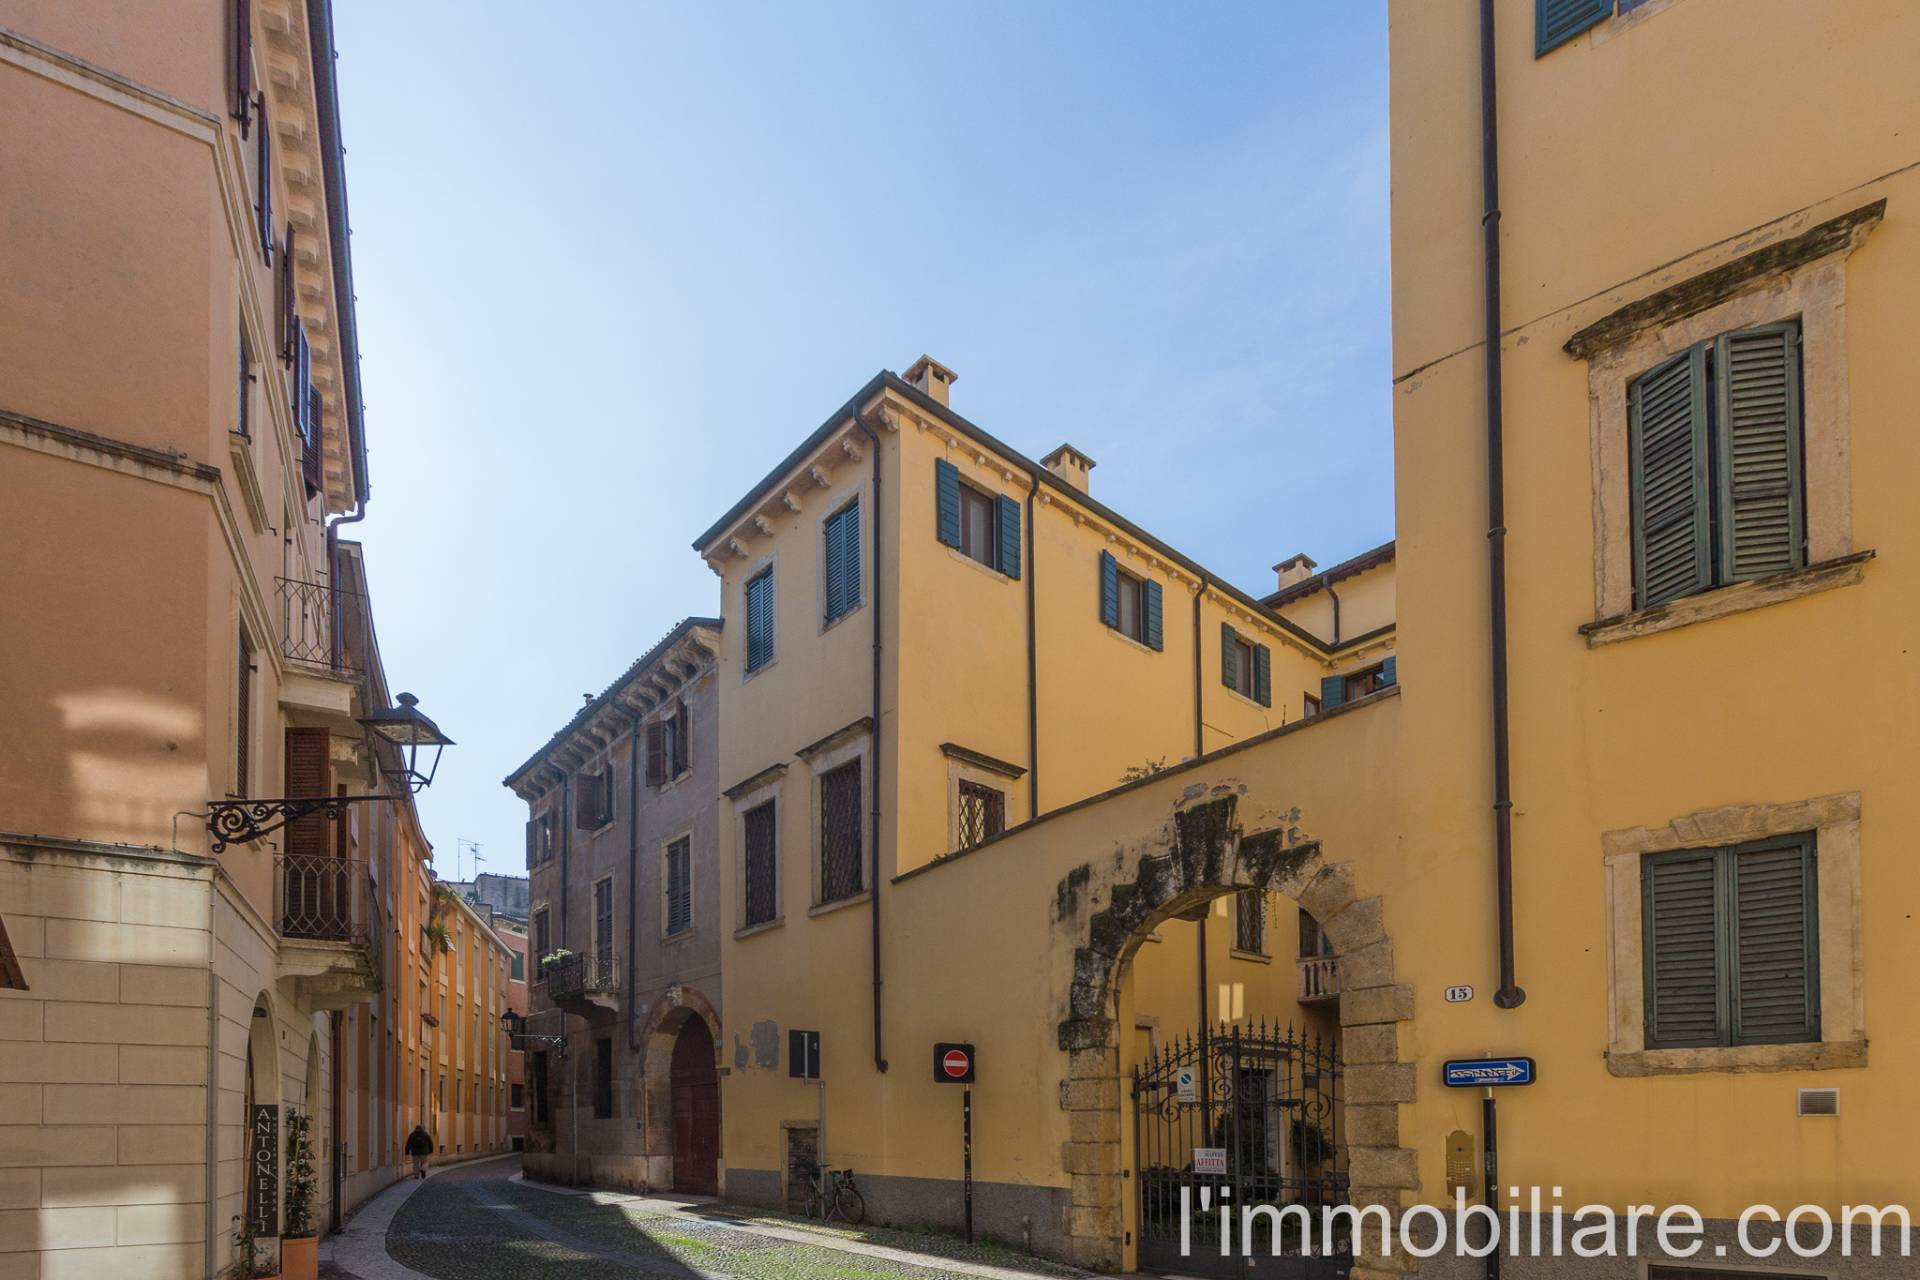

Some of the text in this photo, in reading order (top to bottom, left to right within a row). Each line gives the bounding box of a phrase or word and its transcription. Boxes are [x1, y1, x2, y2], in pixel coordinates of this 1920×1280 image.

[1450, 988, 1468, 1000] 15
[1197, 1158, 1224, 1168] AFFITTA
[256, 1108, 272, 1233] ANTONELLI
